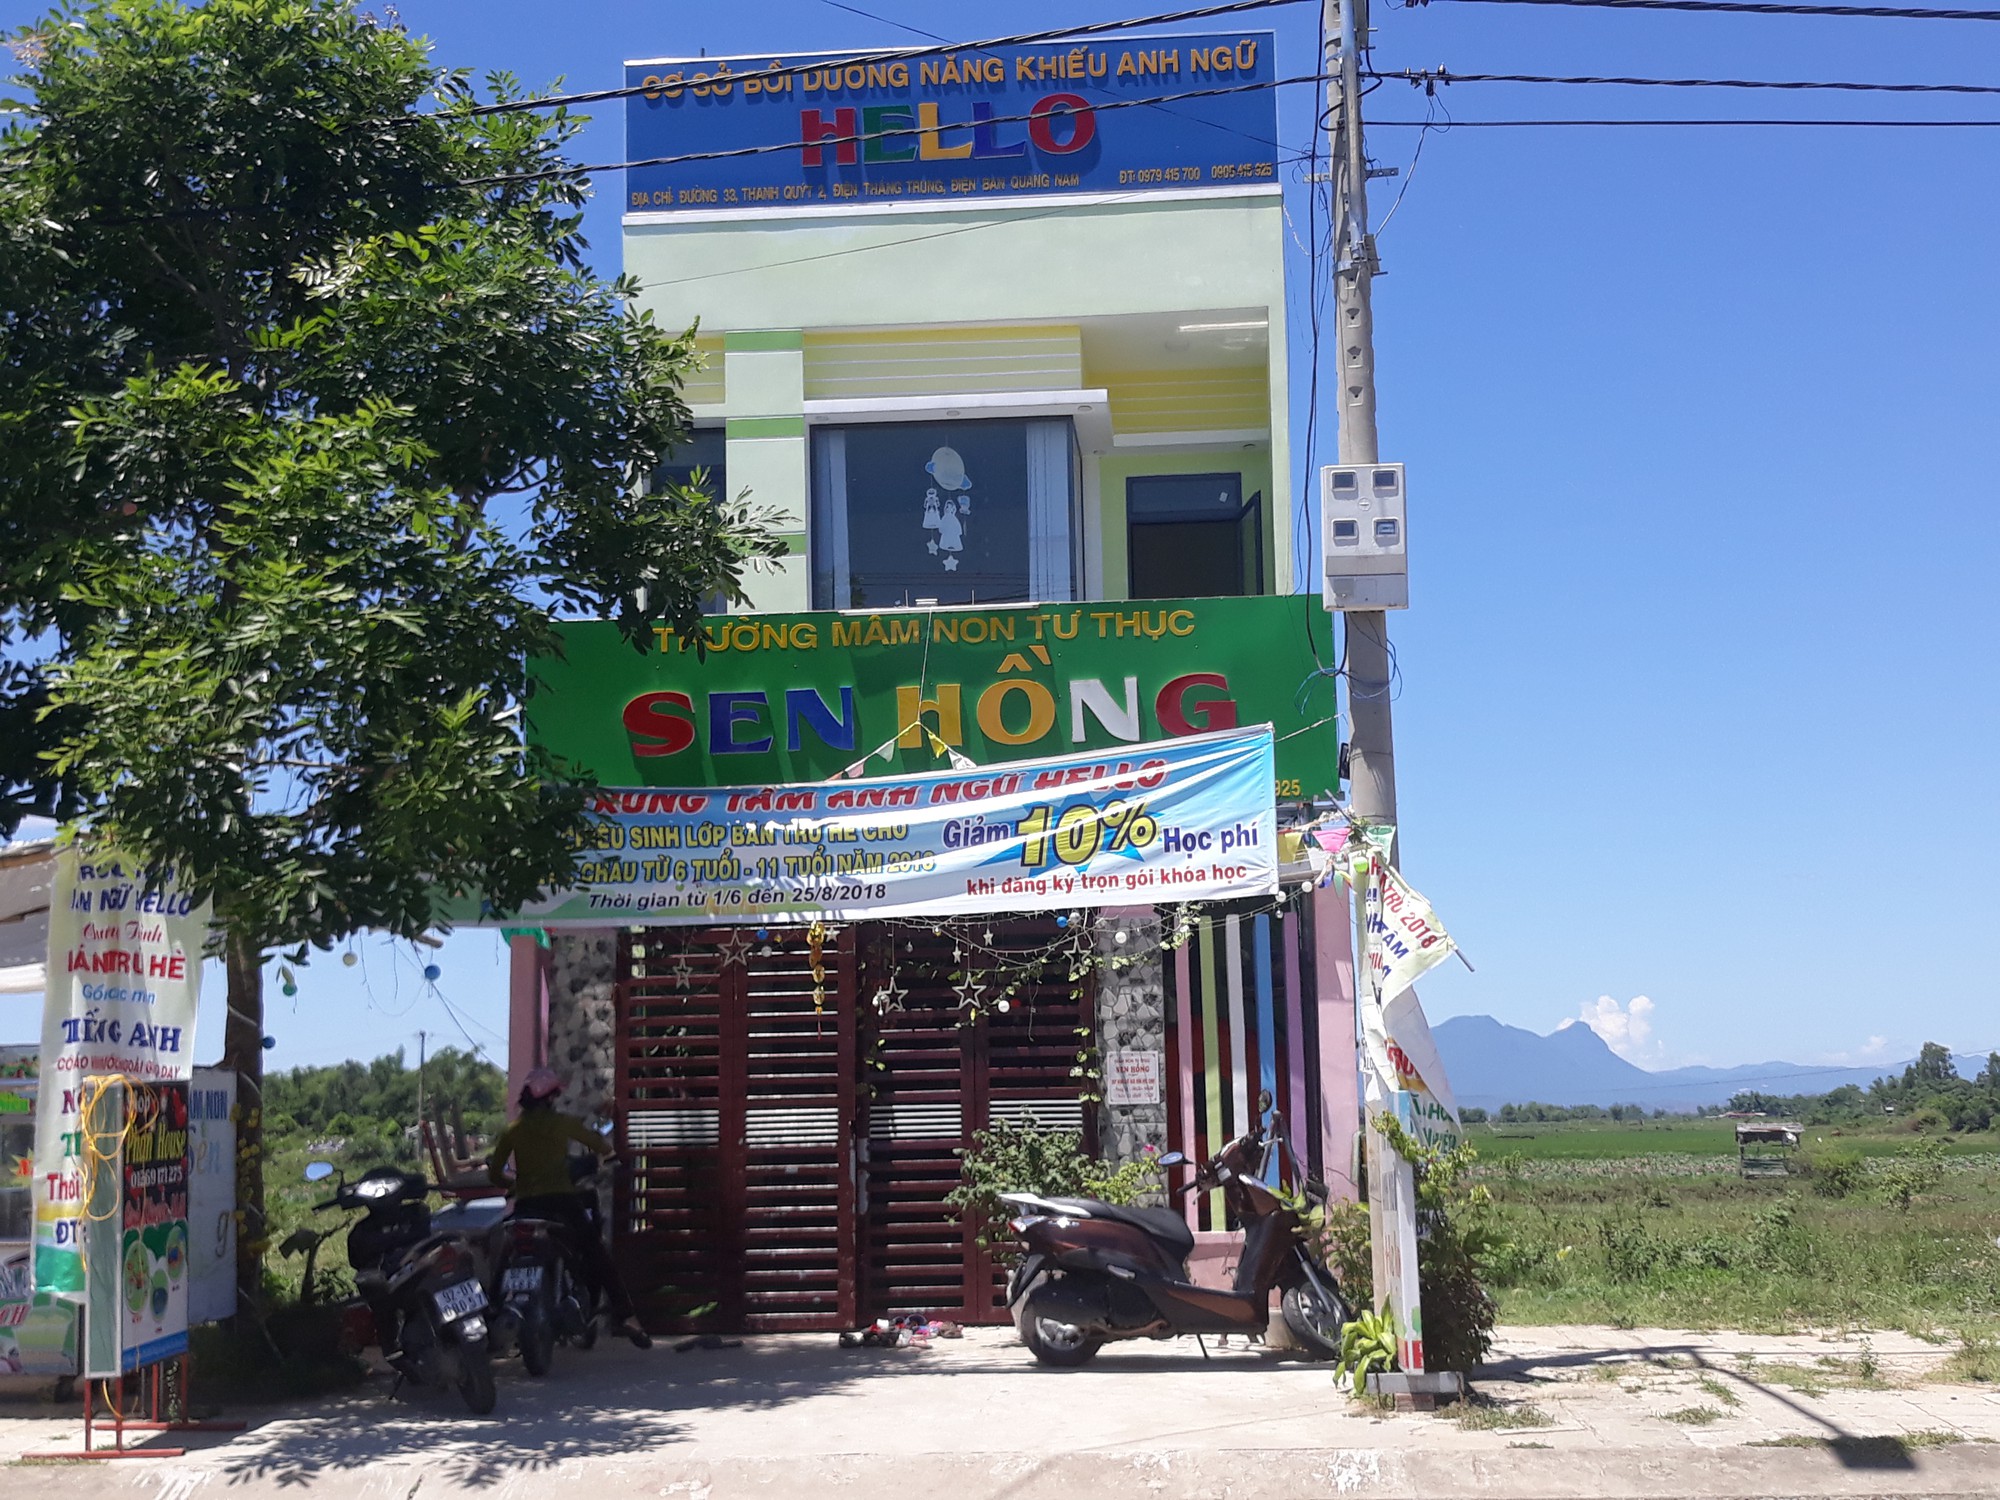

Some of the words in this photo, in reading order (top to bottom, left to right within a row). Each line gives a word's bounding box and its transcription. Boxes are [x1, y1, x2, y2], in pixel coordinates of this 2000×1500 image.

[920, 54, 1005, 85] NĂNG
[1016, 46, 1107, 80] KHIẾU
[1116, 49, 1179, 76] ANH
[1190, 39, 1258, 72] NGỮ
[801, 93, 1096, 167] HELLO
[1138, 169, 1162, 183] 0979
[1182, 167, 1200, 180] 700
[933, 616, 1015, 644] NON
[1027, 610, 1083, 640] TƯ
[1090, 609, 1195, 641] THỤC
[622, 686, 855, 757] SEN
[896, 645, 1236, 750] HỒNG
[592, 792, 709, 814] RUNG
[726, 787, 815, 812] TÂM
[827, 785, 920, 808] ANH
[629, 825, 680, 849] SINH
[686, 821, 726, 847] LỚP
[943, 815, 1008, 848] Giảm
[1014, 799, 1160, 867] 10%
[1163, 827, 1212, 859] Học
[1221, 821, 1259, 854] phí
[642, 854, 671, 882] TỪ
[674, 860, 687, 881] 6
[691, 849, 739, 882] TUỔI
[756, 857, 778, 879] 11
[784, 845, 833, 877] TUỔI
[838, 849, 882, 875] NĂM
[966, 876, 996, 896] khi
[1001, 872, 1047, 896] đăng
[1052, 871, 1075, 894] ký
[1081, 872, 1119, 894] trọn
[1126, 868, 1156, 891] gói
[1160, 864, 1206, 886] khóa
[1212, 862, 1247, 885] học
[589, 890, 631, 909] Thời
[637, 891, 685, 911] gian
[687, 890, 708, 907] từ
[713, 889, 741, 905] 1/6
[748, 886, 785, 904] đến
[792, 884, 886, 903] 25/8/2018
[1400, 912, 1438, 949] 2018
[149, 949, 186, 979] HÈ
[128, 1022, 182, 1052] ANH
